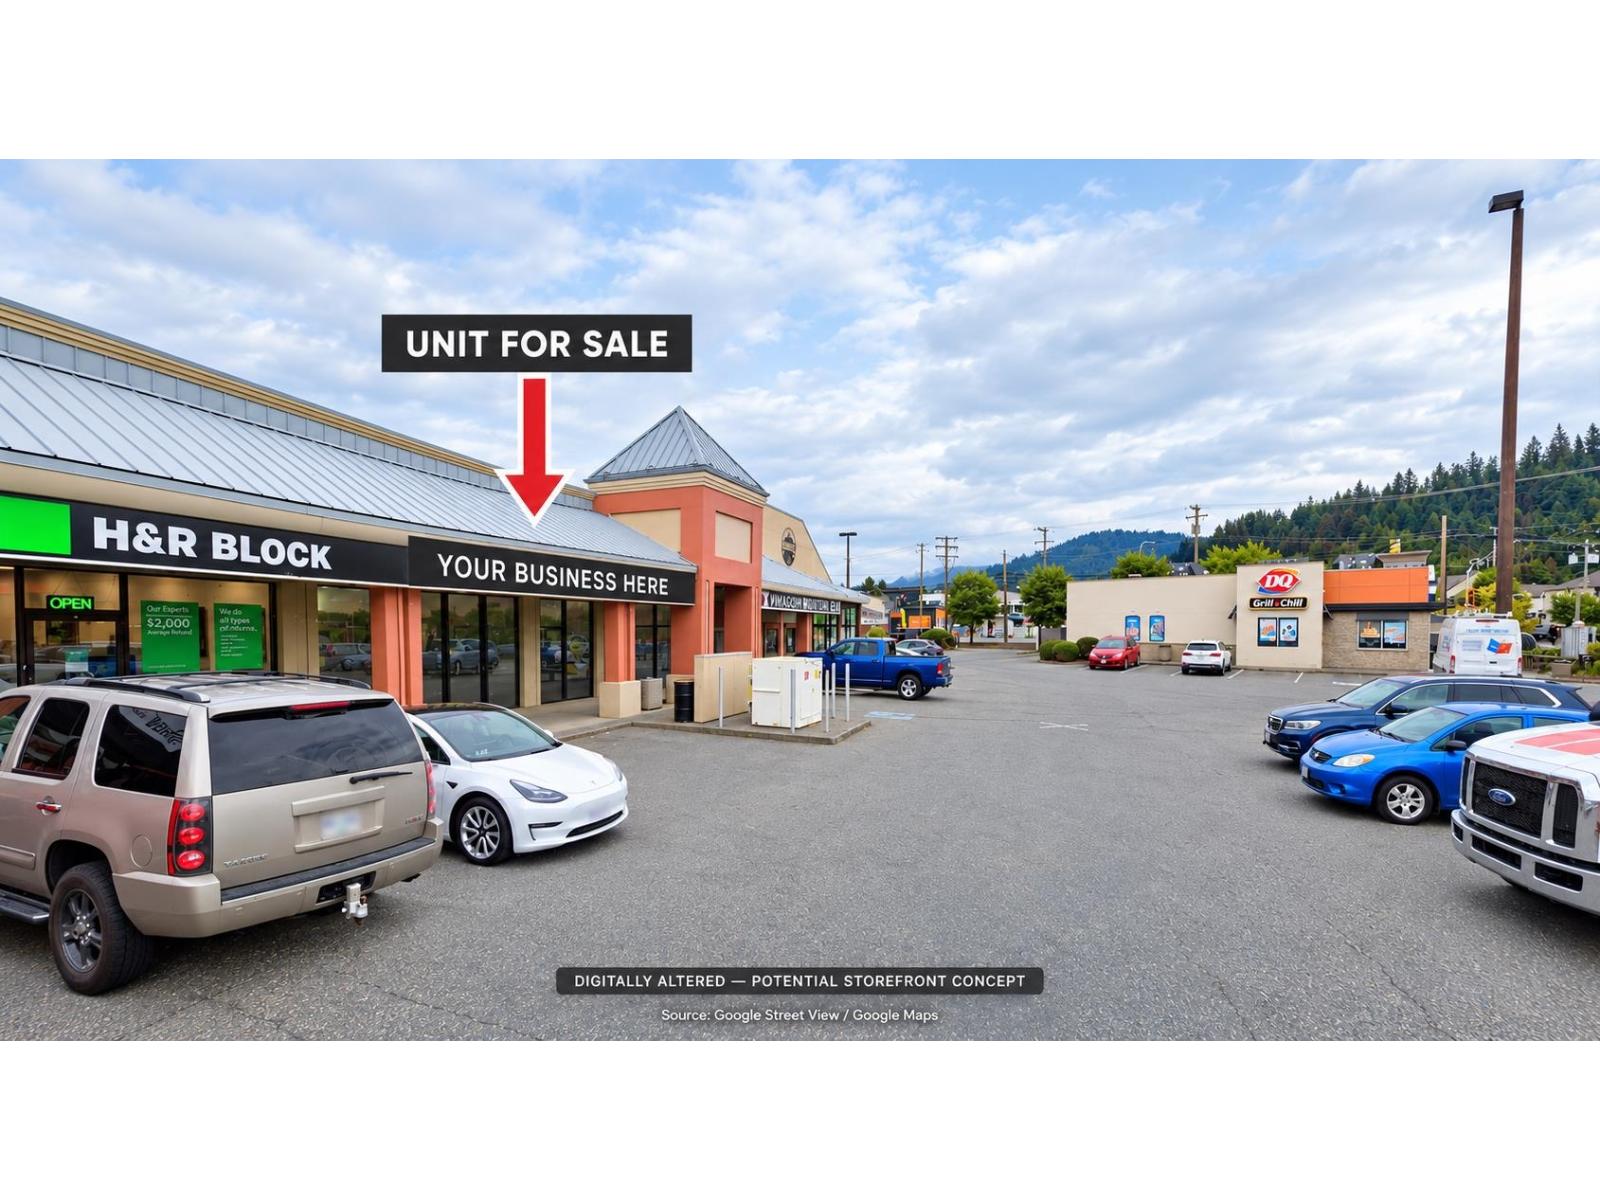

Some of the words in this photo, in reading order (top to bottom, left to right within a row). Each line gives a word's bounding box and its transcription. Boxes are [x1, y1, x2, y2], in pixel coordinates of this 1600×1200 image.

[93, 516, 197, 558] H&R
[212, 531, 332, 570] BLOCK
[437, 554, 506, 582] YOUR
[515, 562, 617, 591] BUSINESS
[623, 574, 669, 595] HERE
[1264, 574, 1293, 588] DQ
[50, 597, 92, 609] OPEN
[1253, 599, 1274, 607] Grill
[1280, 598, 1303, 607] Chill
[147, 618, 190, 629] $2,000
